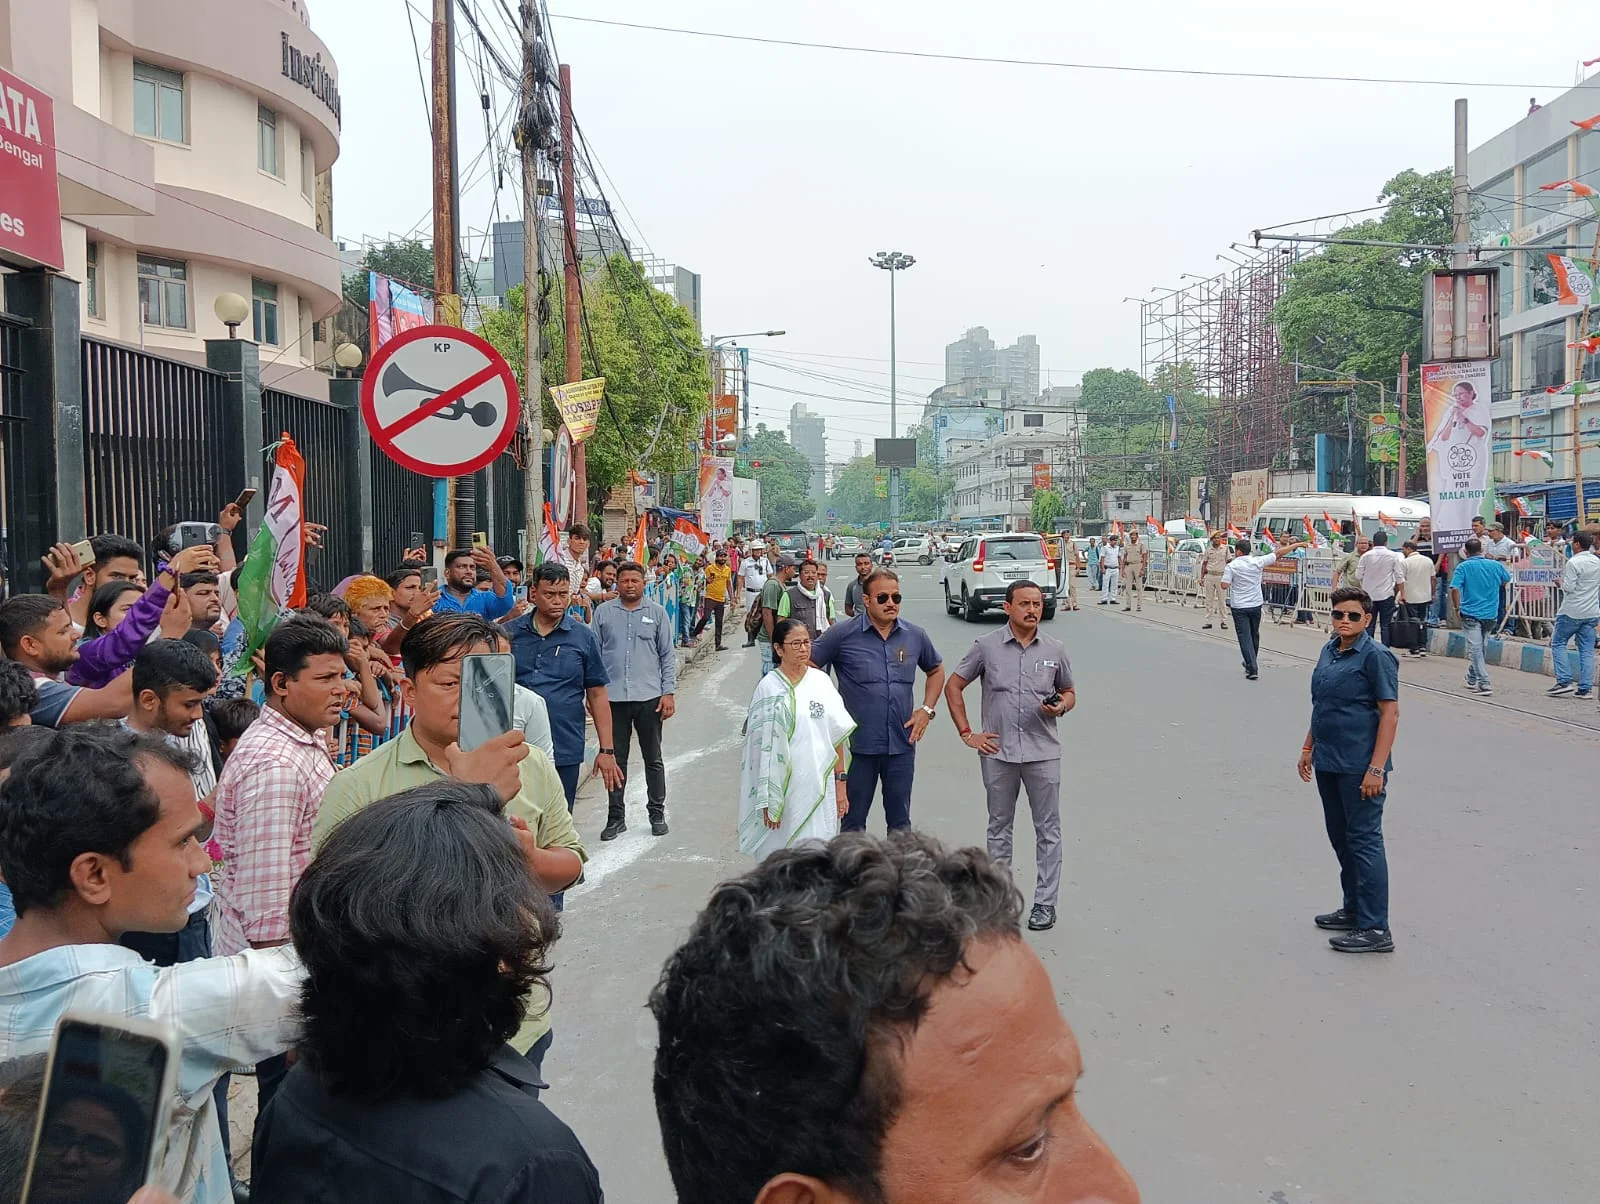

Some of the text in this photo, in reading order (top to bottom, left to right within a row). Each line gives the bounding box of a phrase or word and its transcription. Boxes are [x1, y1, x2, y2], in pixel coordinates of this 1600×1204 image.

[434, 342, 451, 353] KP
[1452, 472, 1472, 480] VOTE
[1455, 481, 1470, 489] FOR
[1439, 489, 1486, 501] MALA ROY
